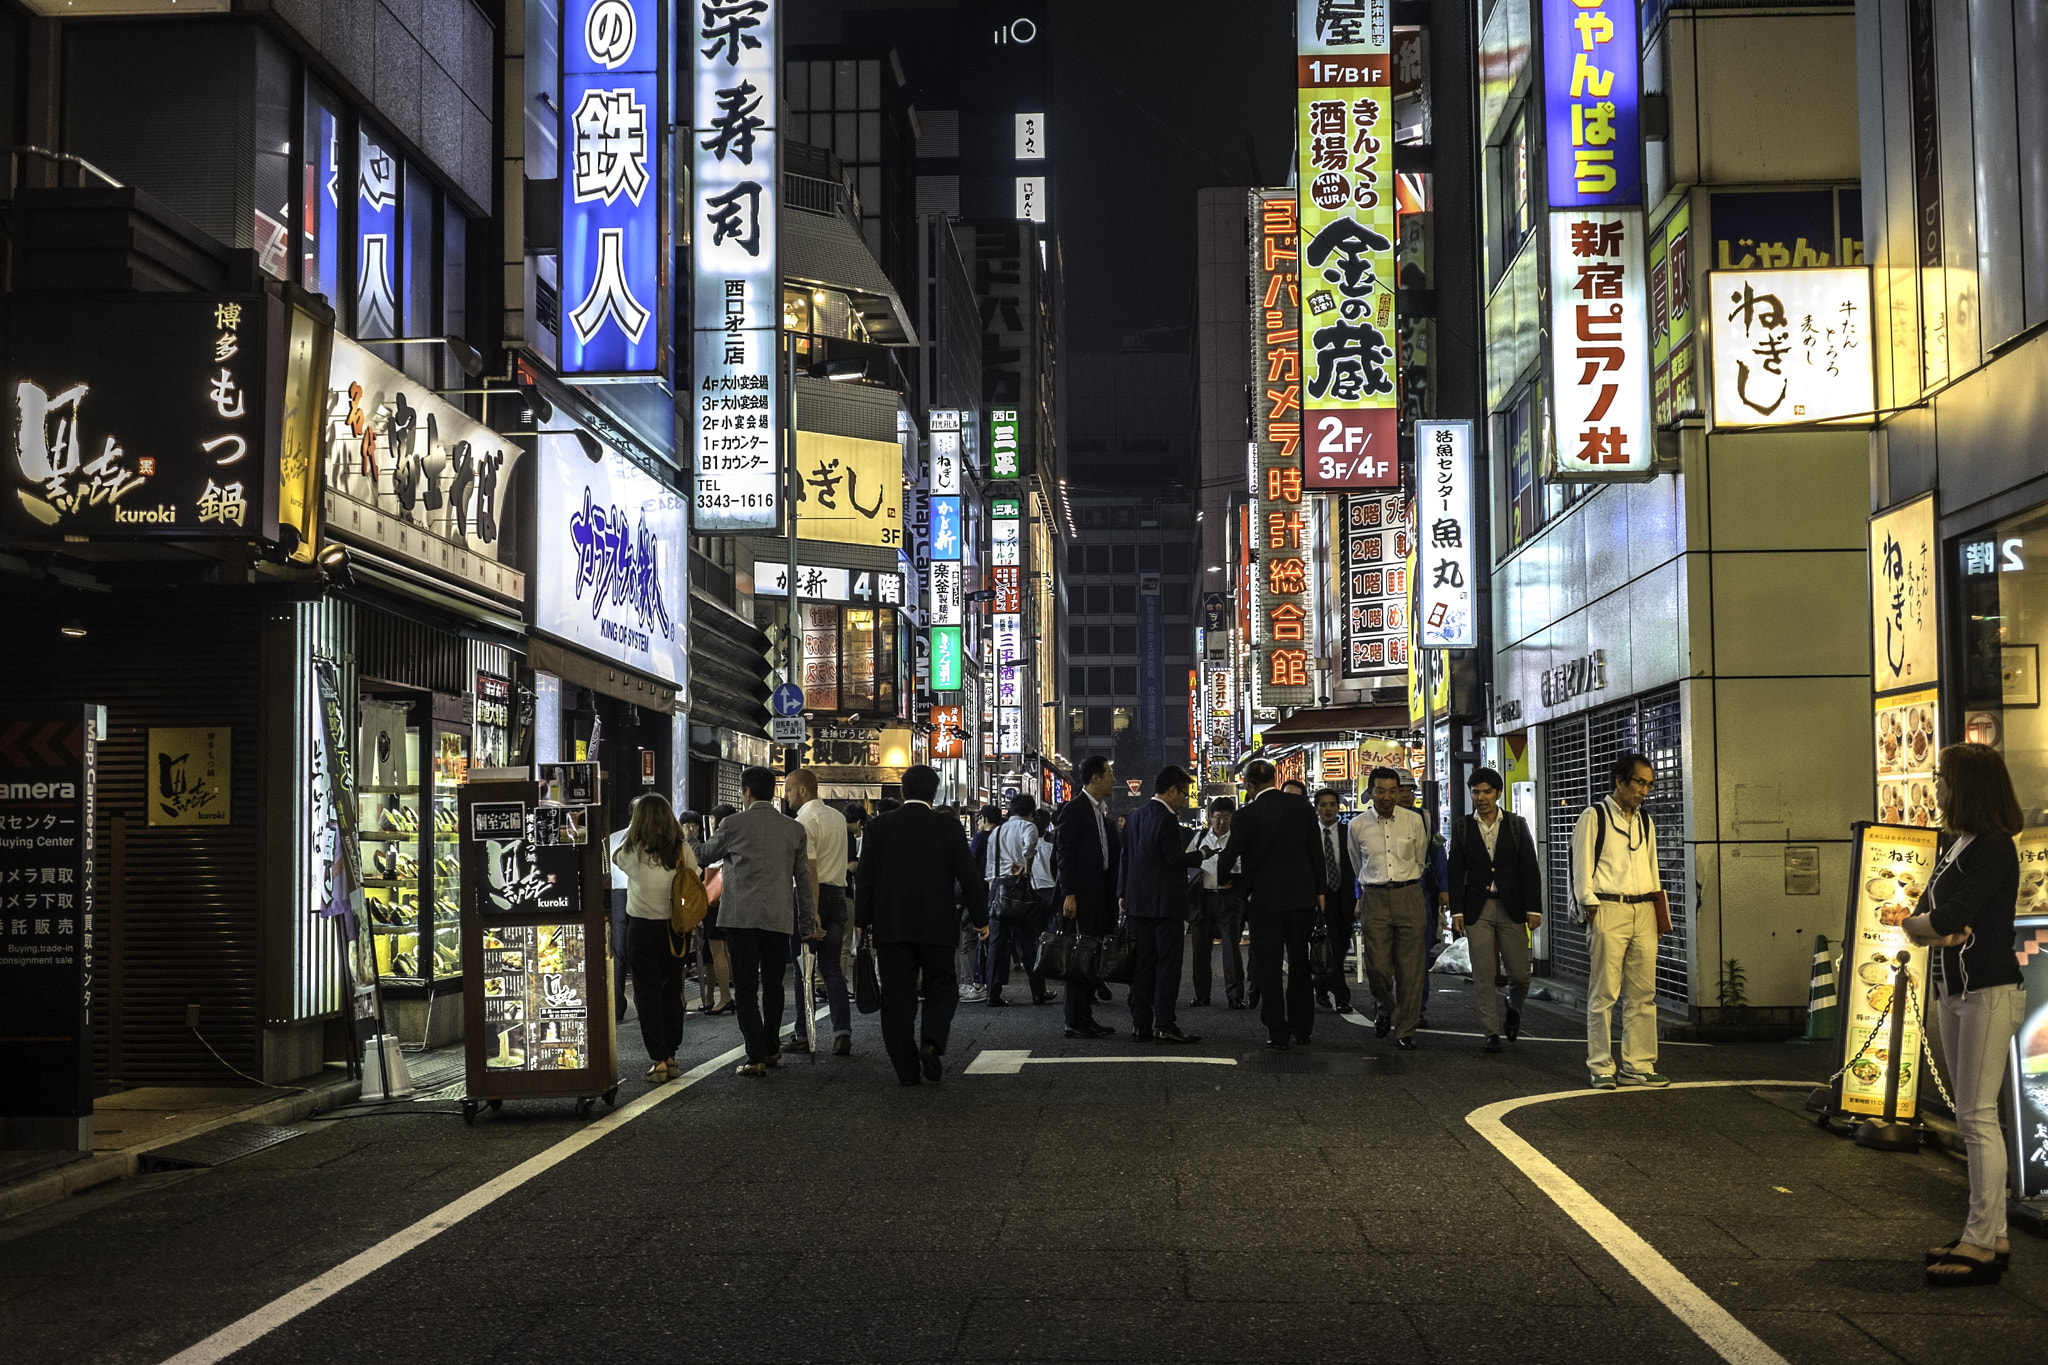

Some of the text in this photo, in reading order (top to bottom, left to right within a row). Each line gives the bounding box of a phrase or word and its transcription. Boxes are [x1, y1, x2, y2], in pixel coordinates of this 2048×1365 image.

[1310, 100, 1349, 172] 酒場
[1352, 98, 1380, 209] きんくら
[1316, 174, 1342, 186] KIN
[1322, 184, 1340, 194] no
[1315, 194, 1348, 206] KURA
[1307, 216, 1394, 401] 金の蔵
[1839, 300, 1858, 348] 牛たん
[1571, 219, 1631, 465] 新宿ピアノ社
[1728, 280, 1792, 416] ねぎし
[1800, 314, 1819, 366] 麦めし
[1826, 326, 1839, 378] とろろ
[702, 375, 769, 392] 4F 大小宴会場
[702, 395, 769, 412] 3F 大小宴会場
[199, 302, 247, 527] 博多もつ鍋
[702, 414, 769, 431] 2F 小宴会場
[992, 411, 1017, 422] 西口
[703, 435, 769, 451] 1F カウンター
[702, 455, 769, 470] B1 カウンター
[936, 454, 952, 488] ねぎし
[1318, 456, 1390, 480] 3F/4F
[697, 480, 721, 492] TEL
[697, 493, 774, 509] 3343-1616
[1431, 429, 1465, 589] 活魚センター 魚丸
[115, 504, 176, 523] kuroki
[1351, 504, 1381, 525] 3階
[880, 527, 901, 544] 3F
[911, 489, 930, 627] Map Camra
[996, 540, 1005, 559] ホール
[1352, 538, 1381, 559] 2階
[853, 571, 901, 604] 4階
[934, 563, 950, 623] 楽釜製麺所
[1353, 572, 1382, 595] 1階
[1882, 528, 1906, 678] ねぎし
[600, 618, 649, 654] KING OF SYSTEM
[916, 635, 930, 697] CMT
[1215, 672, 1227, 709] カラオケ
[1361, 749, 1403, 764] きんくら
[198, 810, 226, 820] kuroki
[475, 812, 522, 832] 個室完備
[36, 836, 75, 847] Center
[1887, 848, 1927, 866] ねぎし
[83, 719, 96, 1026] Map Camera カメラ買取センター
[537, 896, 568, 908] kuroki
[54, 956, 74, 965] sale
